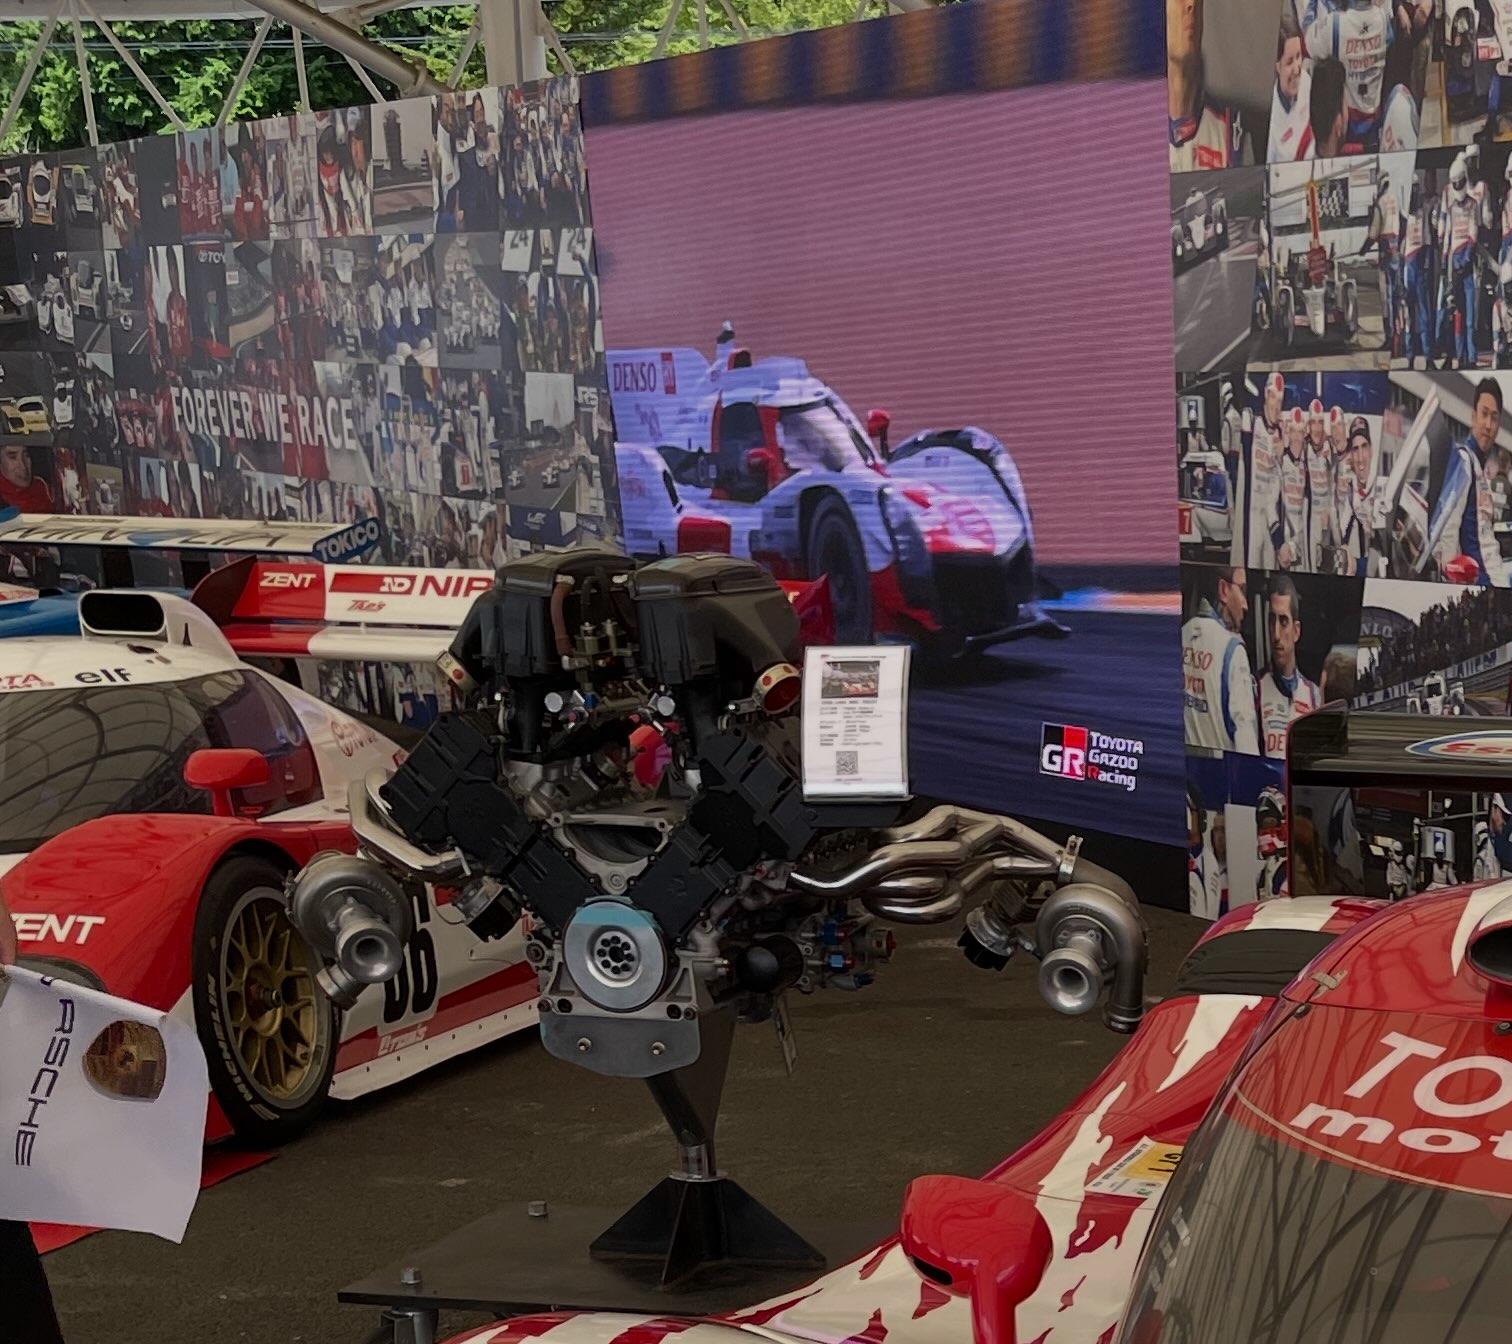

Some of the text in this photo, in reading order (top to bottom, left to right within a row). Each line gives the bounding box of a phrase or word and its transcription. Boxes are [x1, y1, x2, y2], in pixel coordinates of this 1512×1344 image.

[612, 362, 657, 393] DENSO
[170, 385, 358, 451] FOREVER WE RACE
[315, 520, 380, 562] TOKICO
[259, 571, 317, 589] ZENT
[0, 673, 43, 686] TA
[75, 666, 133, 686] elf
[1089, 731, 1144, 755] TOYOTA
[1042, 743, 1086, 776] GR
[1088, 749, 1139, 771] GAZOO
[1087, 765, 1137, 792] Racing
[15, 998, 75, 1168] RSCHE
